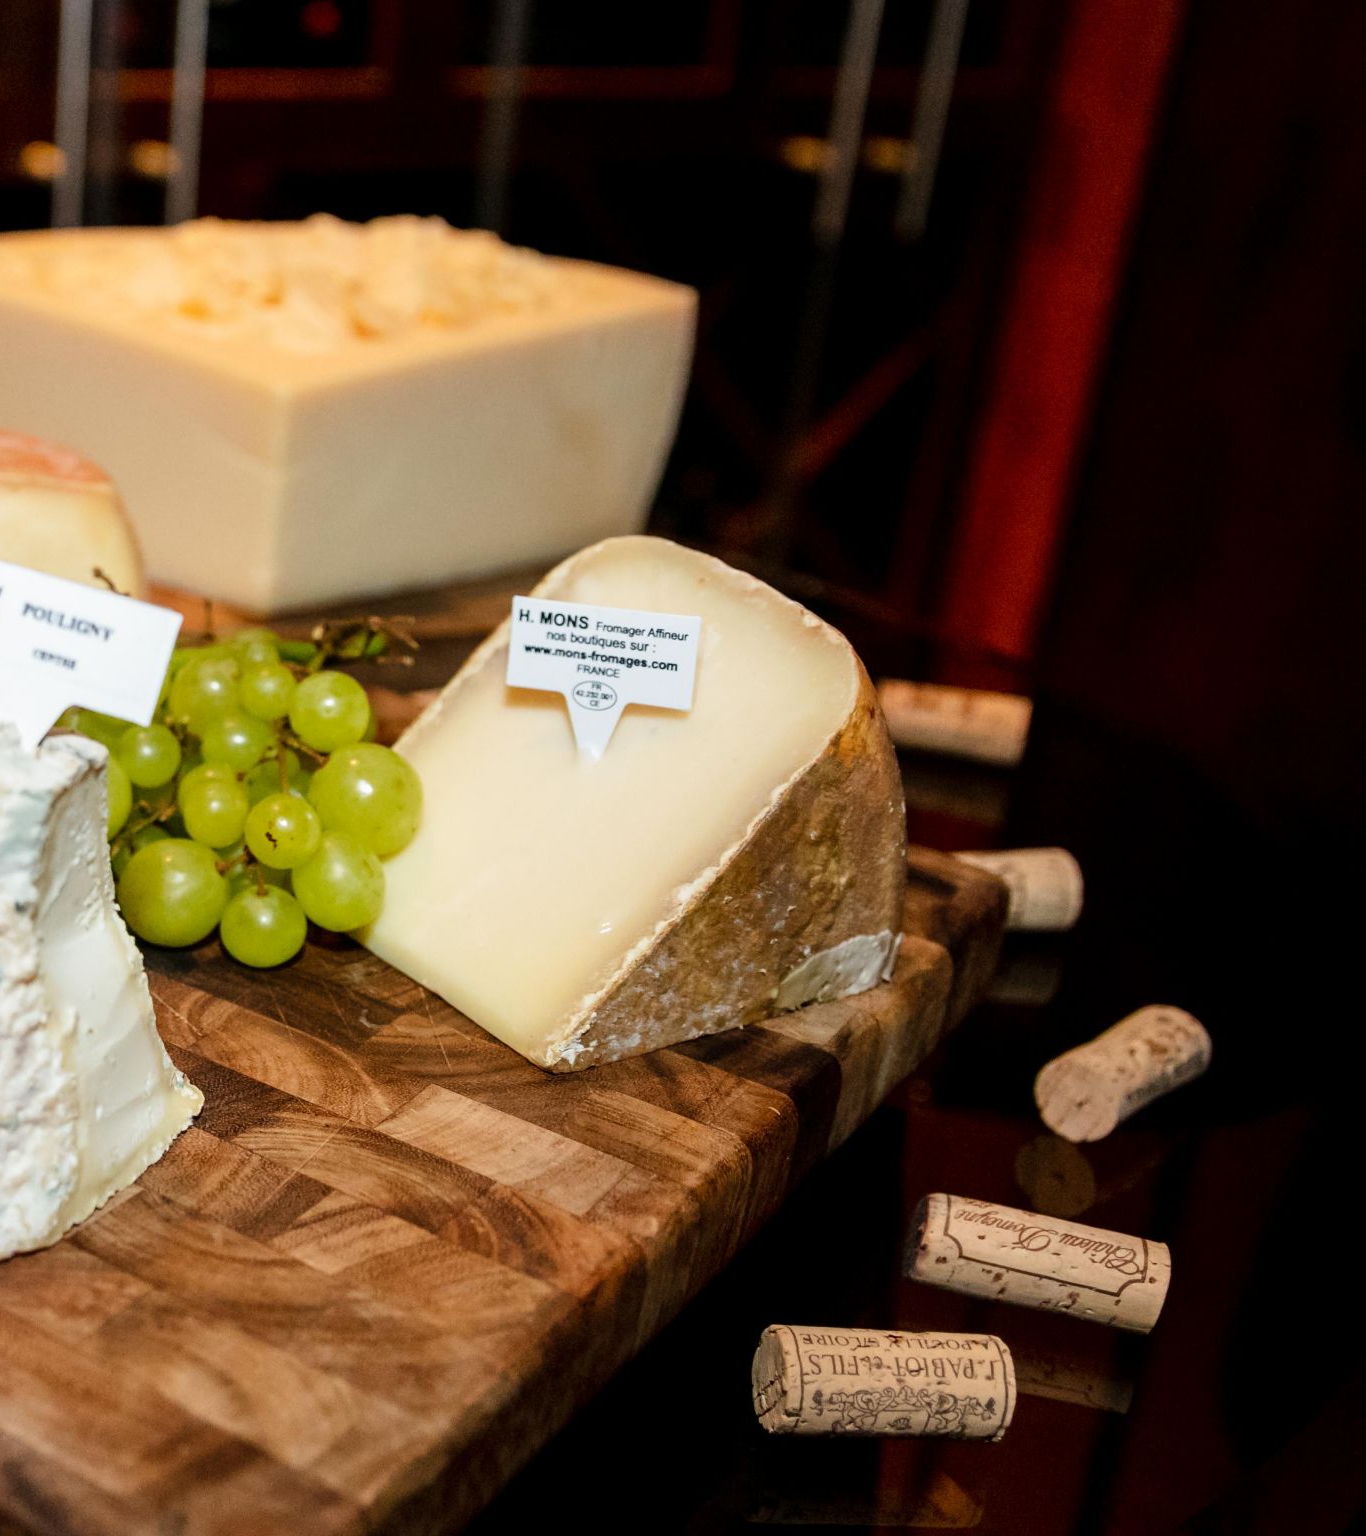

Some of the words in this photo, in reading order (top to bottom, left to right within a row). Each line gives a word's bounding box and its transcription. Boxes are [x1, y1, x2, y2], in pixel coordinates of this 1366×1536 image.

[22, 603, 113, 641] POULIGNY
[519, 608, 534, 623] H.
[540, 611, 589, 630] MONS
[596, 621, 645, 638] Fromager
[648, 627, 689, 641] Affineur
[546, 630, 567, 642] nos
[570, 632, 626, 649] boutiques
[630, 641, 649, 652] sur
[524, 643, 678, 671] www.mons-fromages.com
[577, 663, 620, 679] FRANCE
[954, 1208, 1058, 1252] Domeyne
[1058, 1231, 1143, 1276] Château
[808, 1354, 860, 1376] FILS
[892, 1356, 976, 1380] PABIOT
